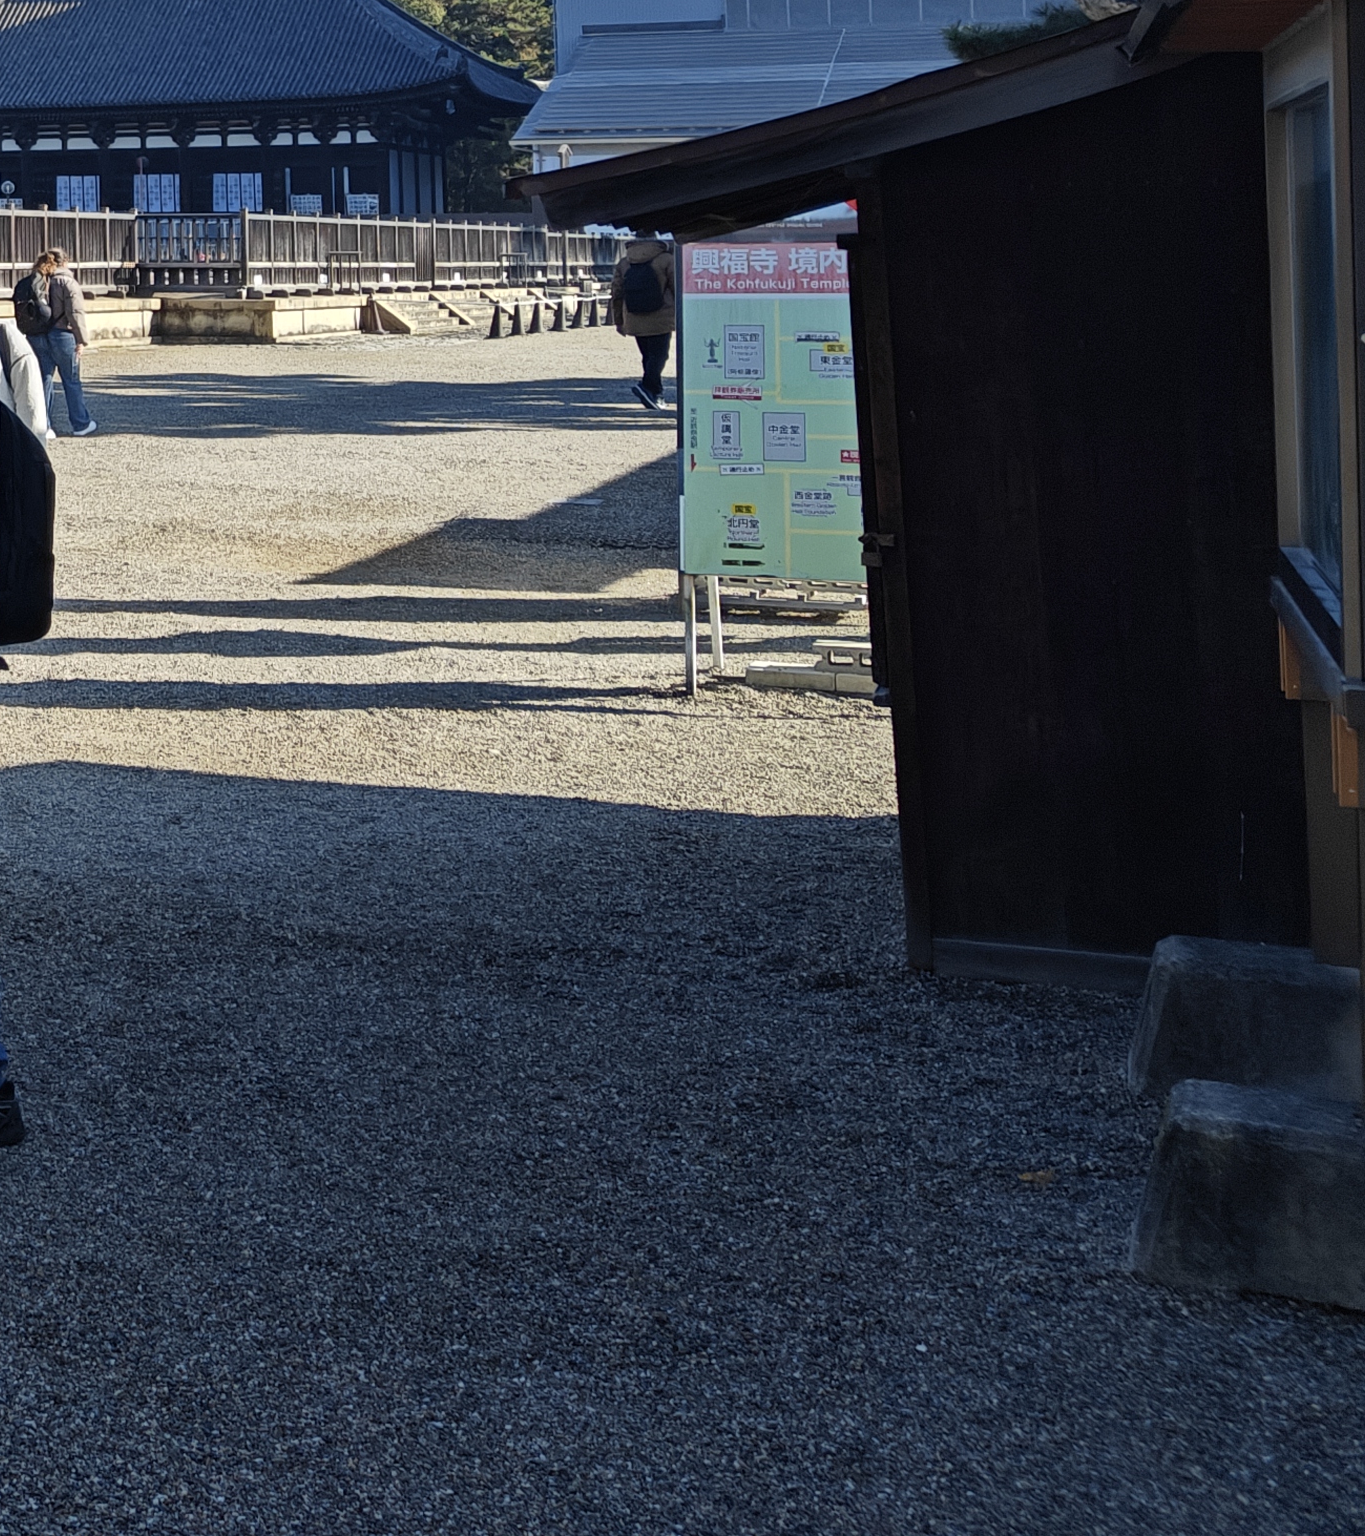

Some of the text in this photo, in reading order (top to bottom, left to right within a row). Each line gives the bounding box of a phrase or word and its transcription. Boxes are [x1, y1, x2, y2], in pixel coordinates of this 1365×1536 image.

[692, 247, 848, 275] 興福寺 境内
[694, 278, 722, 290] The
[726, 278, 796, 291] Kohfukuji
[820, 355, 853, 365] 東金堂
[767, 425, 801, 435] 中金堂
[728, 517, 760, 529] 北円堂
